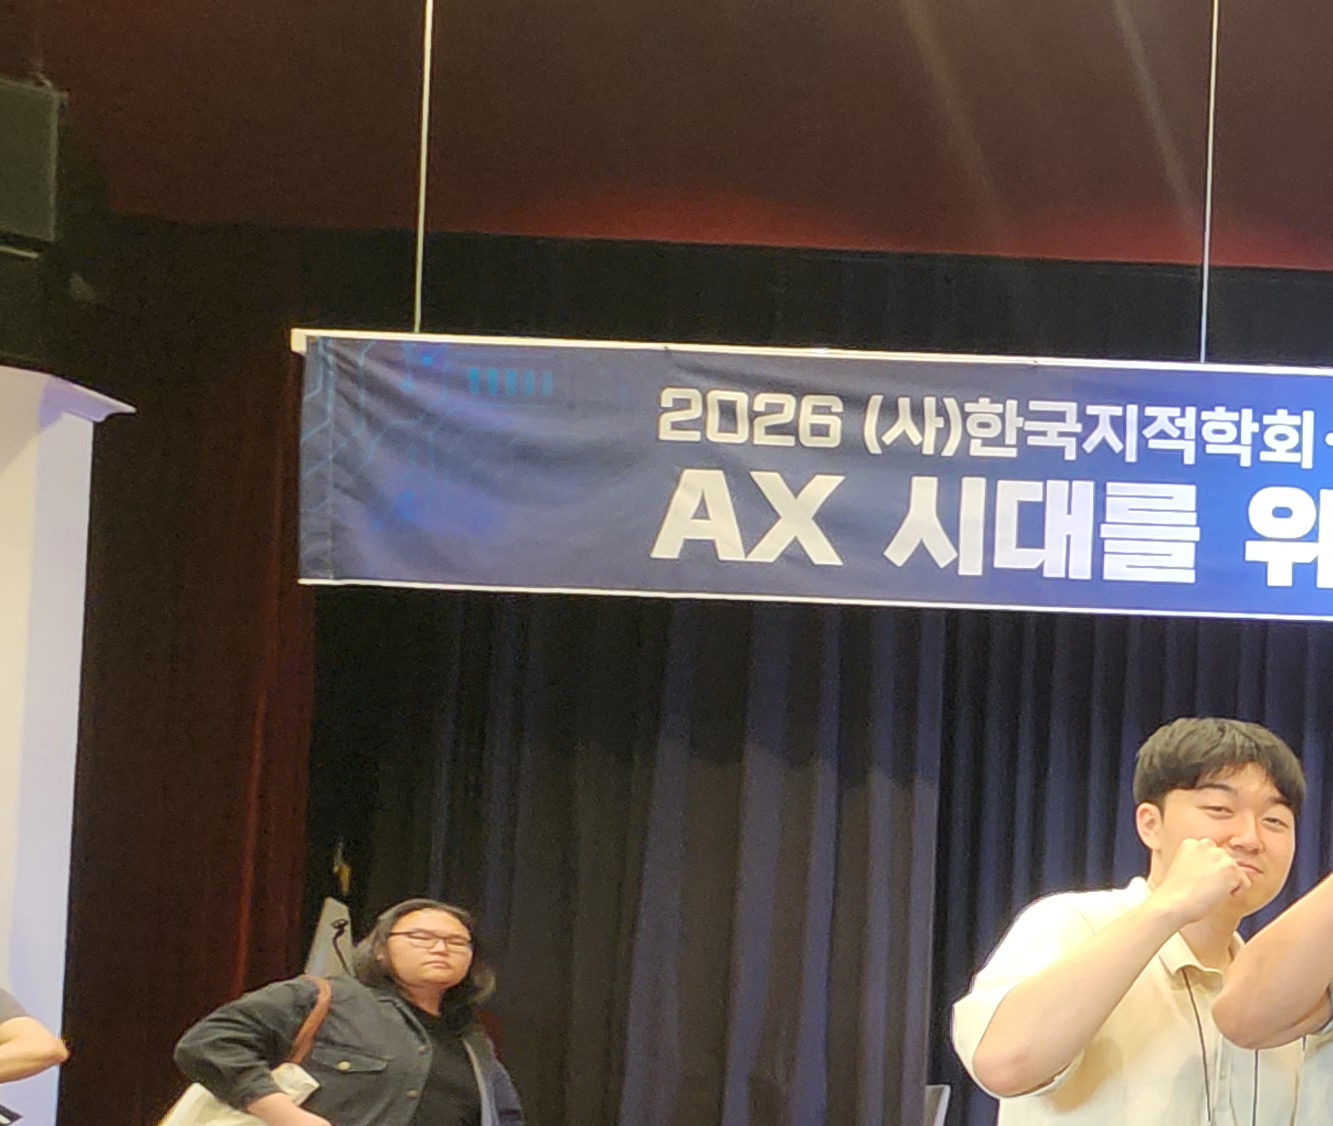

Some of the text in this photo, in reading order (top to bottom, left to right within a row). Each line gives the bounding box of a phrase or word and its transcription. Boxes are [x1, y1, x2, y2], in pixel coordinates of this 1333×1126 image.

[658, 387, 844, 448] 2026
[650, 468, 846, 567] AX
[883, 475, 1200, 584] 시대를
